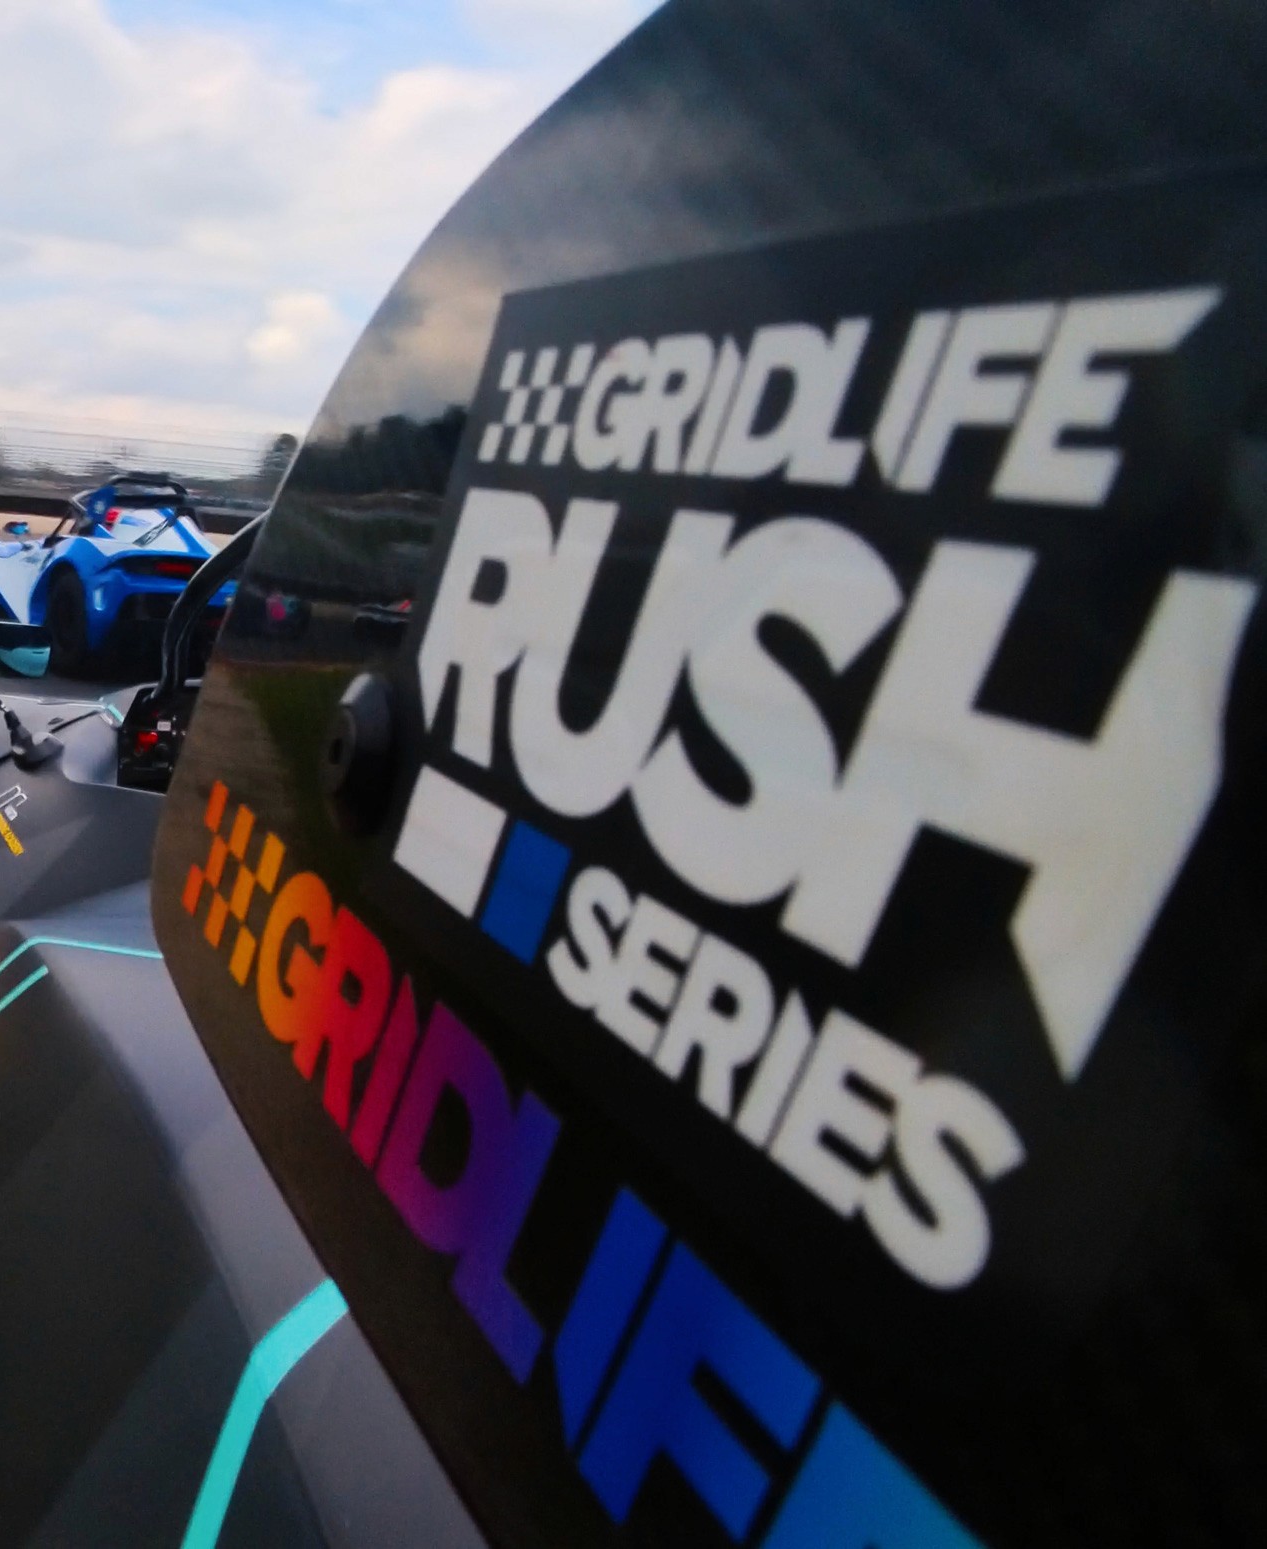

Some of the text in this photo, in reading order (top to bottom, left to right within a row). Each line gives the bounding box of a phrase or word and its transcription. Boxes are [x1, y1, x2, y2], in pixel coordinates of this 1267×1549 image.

[572, 286, 1222, 506] GRIDLIFE
[419, 490, 1260, 1082] RUSH
[546, 866, 1026, 1291] SERIES
